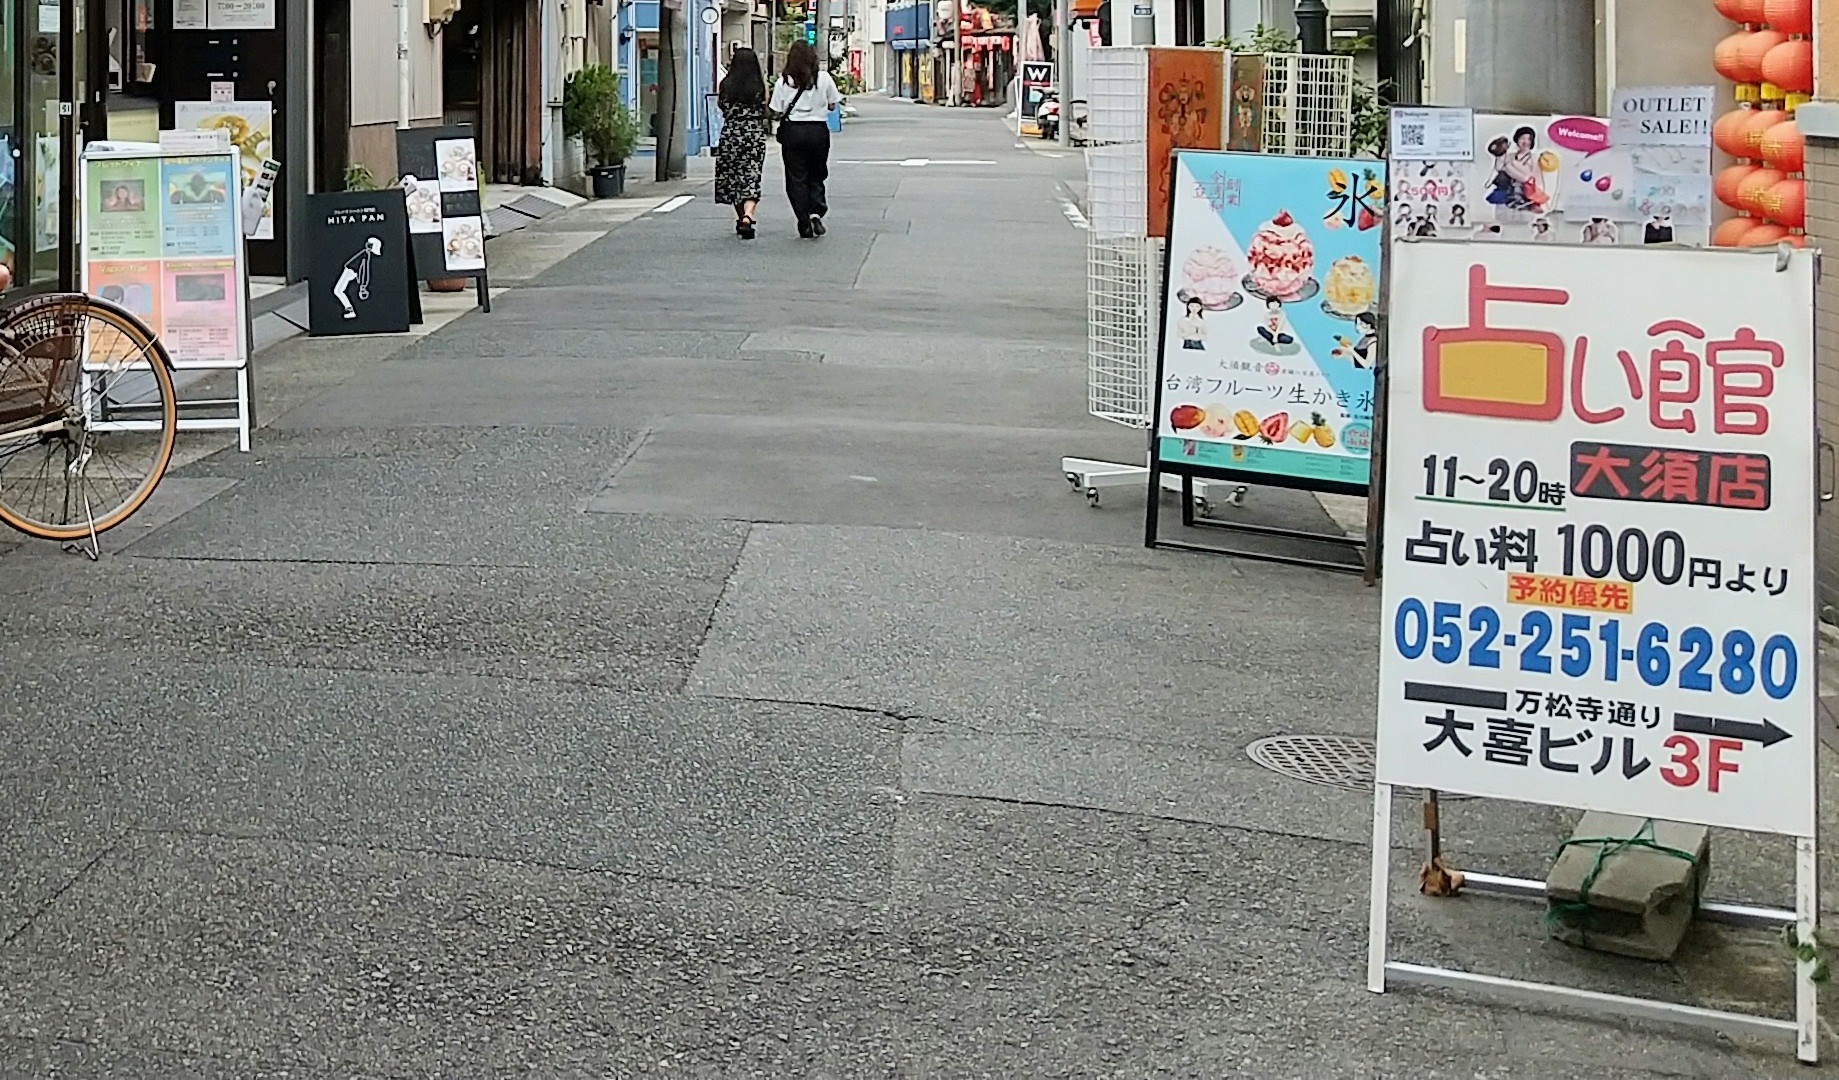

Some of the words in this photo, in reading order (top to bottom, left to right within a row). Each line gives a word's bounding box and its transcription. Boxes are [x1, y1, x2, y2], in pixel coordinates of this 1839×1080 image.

[1623, 97, 1706, 114] OUTLET
[1557, 126, 1604, 142] Welcome!!
[1640, 119, 1708, 135] SALE!!
[327, 215, 356, 225] HITA
[361, 213, 385, 222] PAN
[1323, 172, 1378, 228] 氷
[1423, 263, 1785, 436] 占い館
[1166, 373, 1374, 413] 台湾フルーツ生かき氷
[1575, 445, 1768, 508] 大須店
[1405, 520, 1539, 573] 占い料
[1556, 523, 1789, 597] 1000円より
[1509, 576, 1630, 611] 予約優先
[1394, 598, 1798, 700] 052-251-6280
[1514, 689, 1662, 729] 万松寺通り
[1423, 709, 1651, 780] 大喜ビル
[1659, 736, 1744, 794] 3F
